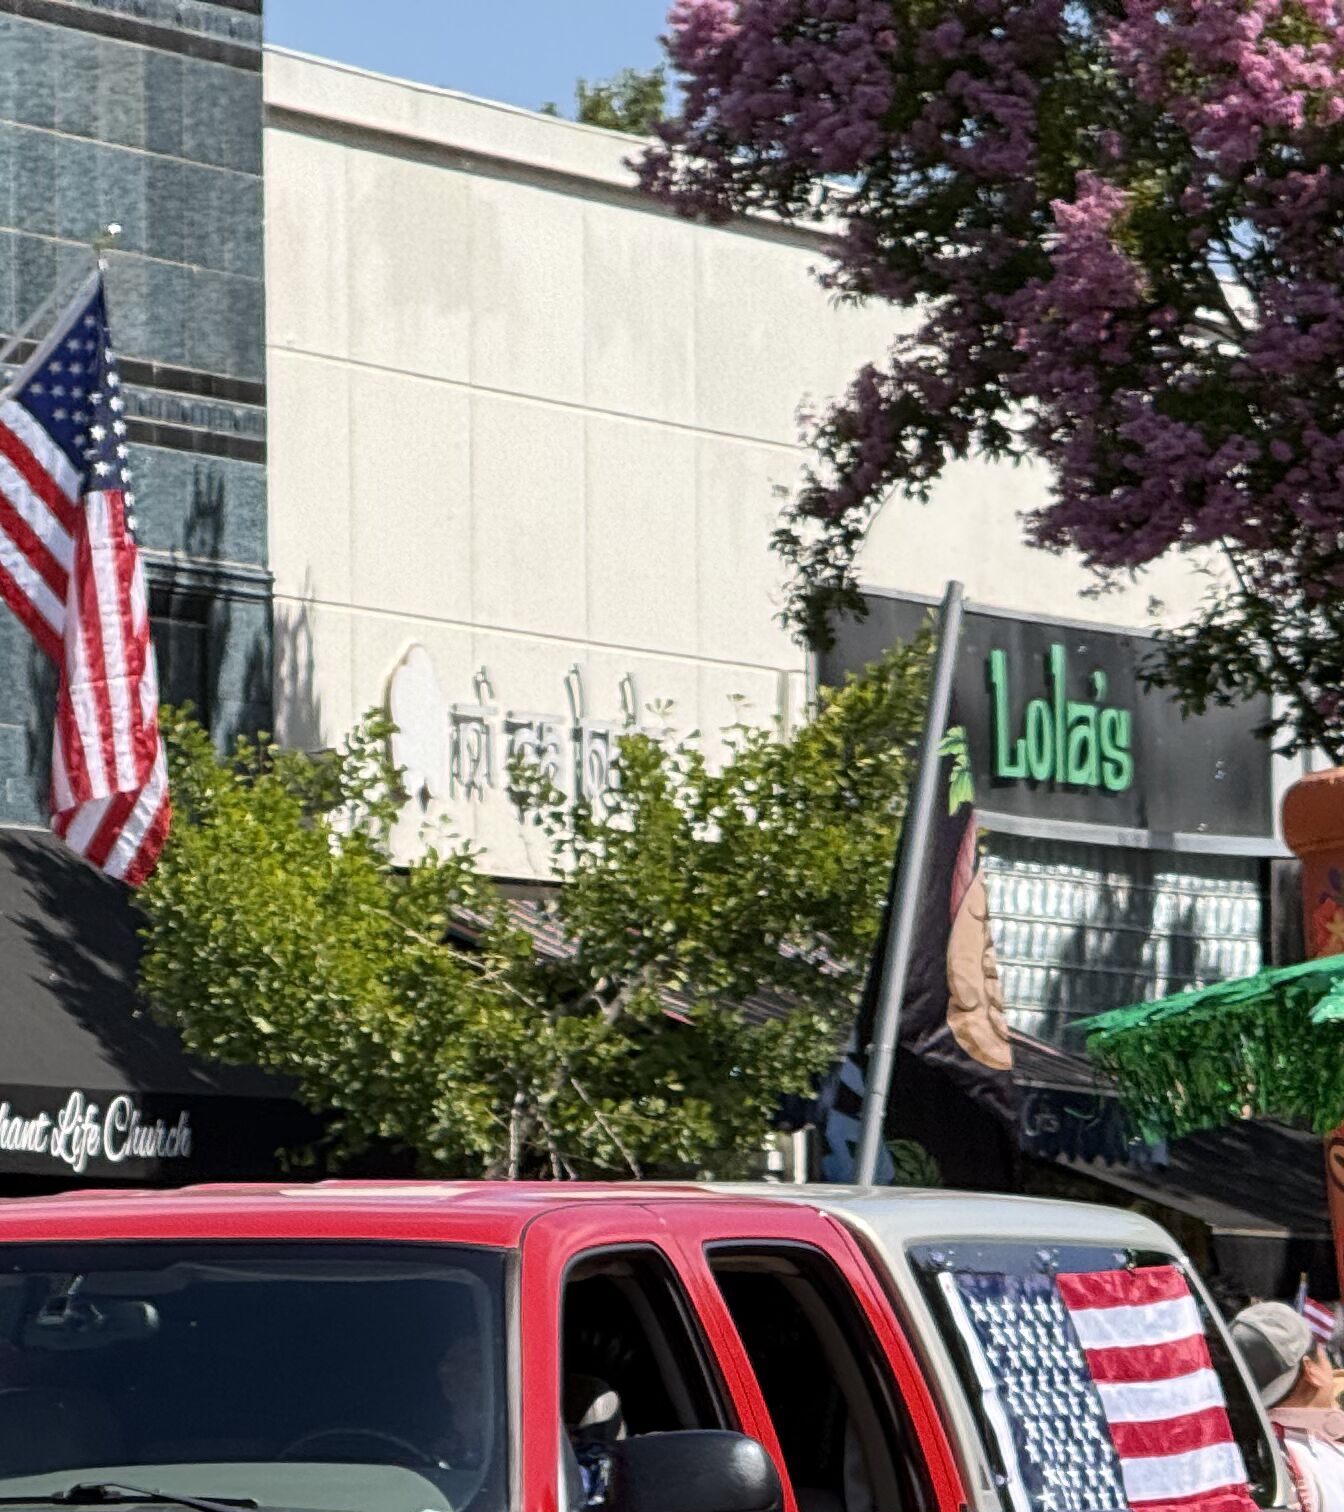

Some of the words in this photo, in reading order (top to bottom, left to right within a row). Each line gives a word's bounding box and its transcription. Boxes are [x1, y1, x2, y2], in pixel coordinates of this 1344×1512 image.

[988, 643, 1134, 792] Lola's
[50, 1090, 102, 1173] Life
[104, 1094, 193, 1163] Church
